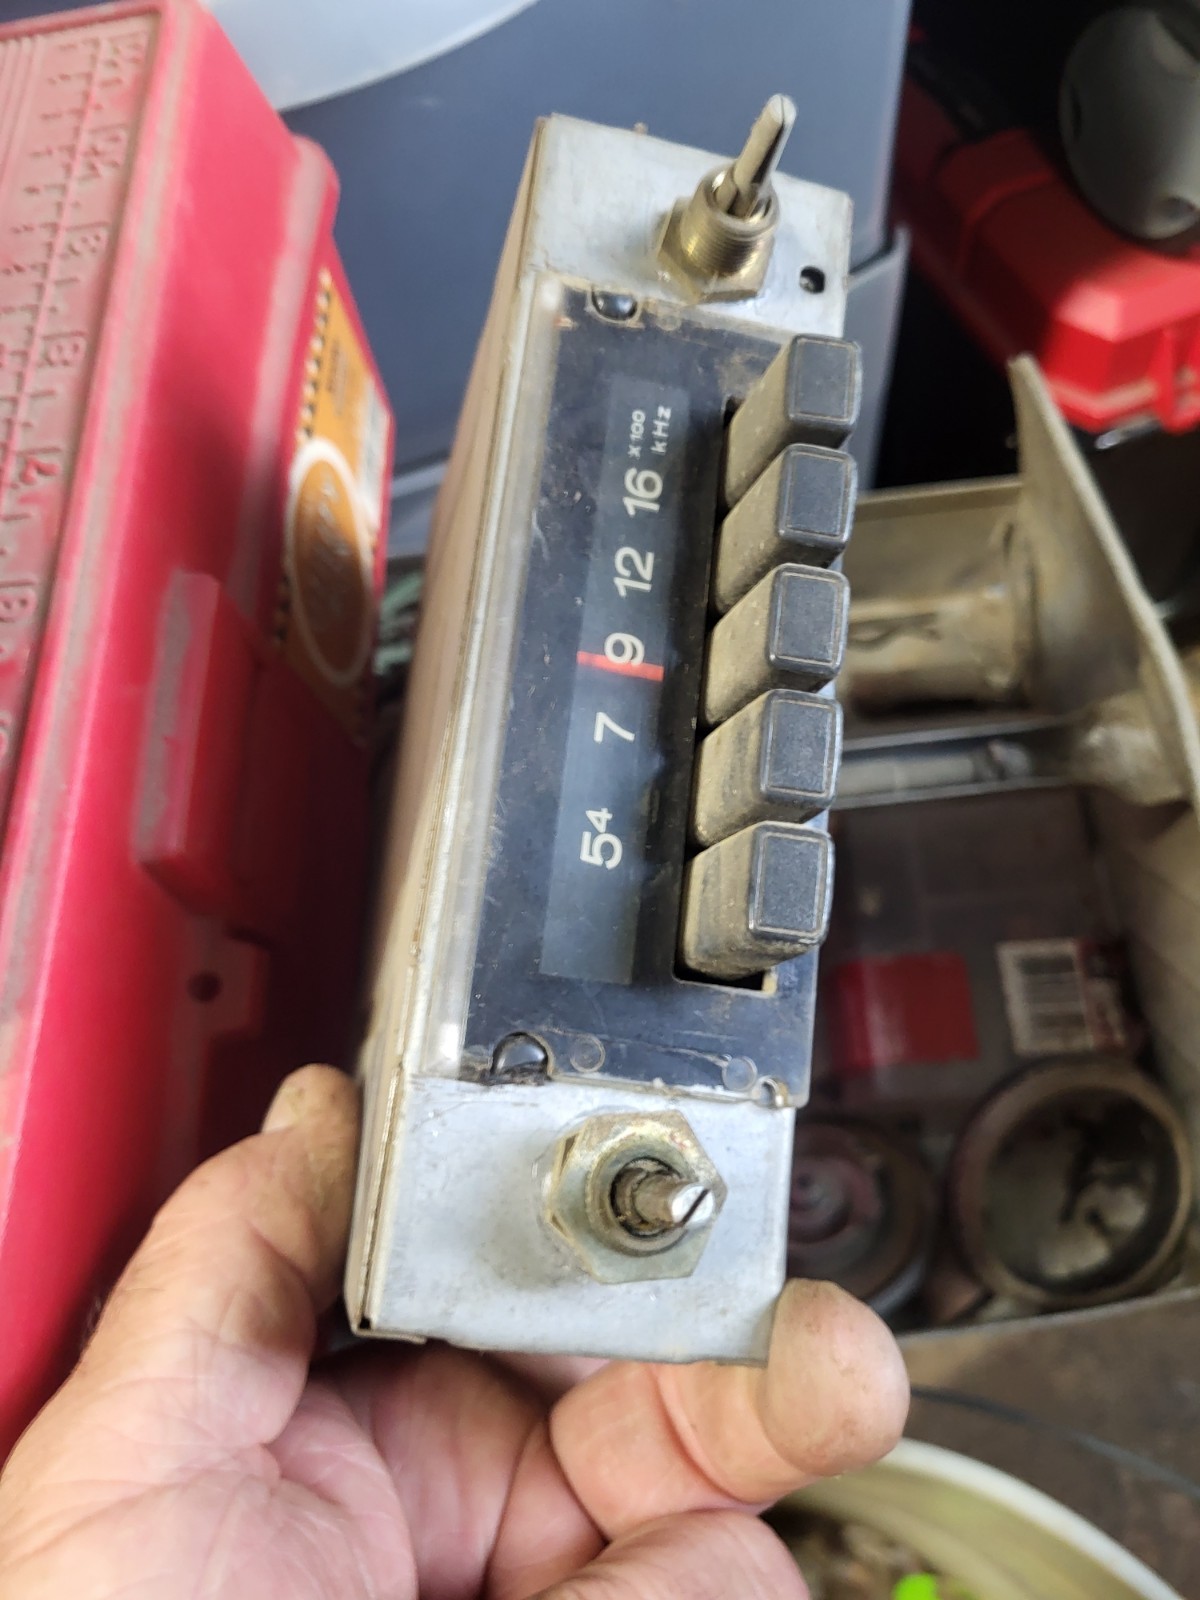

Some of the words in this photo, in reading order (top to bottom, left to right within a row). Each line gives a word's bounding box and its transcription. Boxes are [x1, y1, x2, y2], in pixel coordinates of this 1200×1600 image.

[630, 409, 645, 440] 100
[651, 405, 671, 455] kHz
[622, 467, 663, 517] 16
[613, 546, 655, 597] 12
[604, 632, 645, 667] 9
[594, 712, 635, 742] 7
